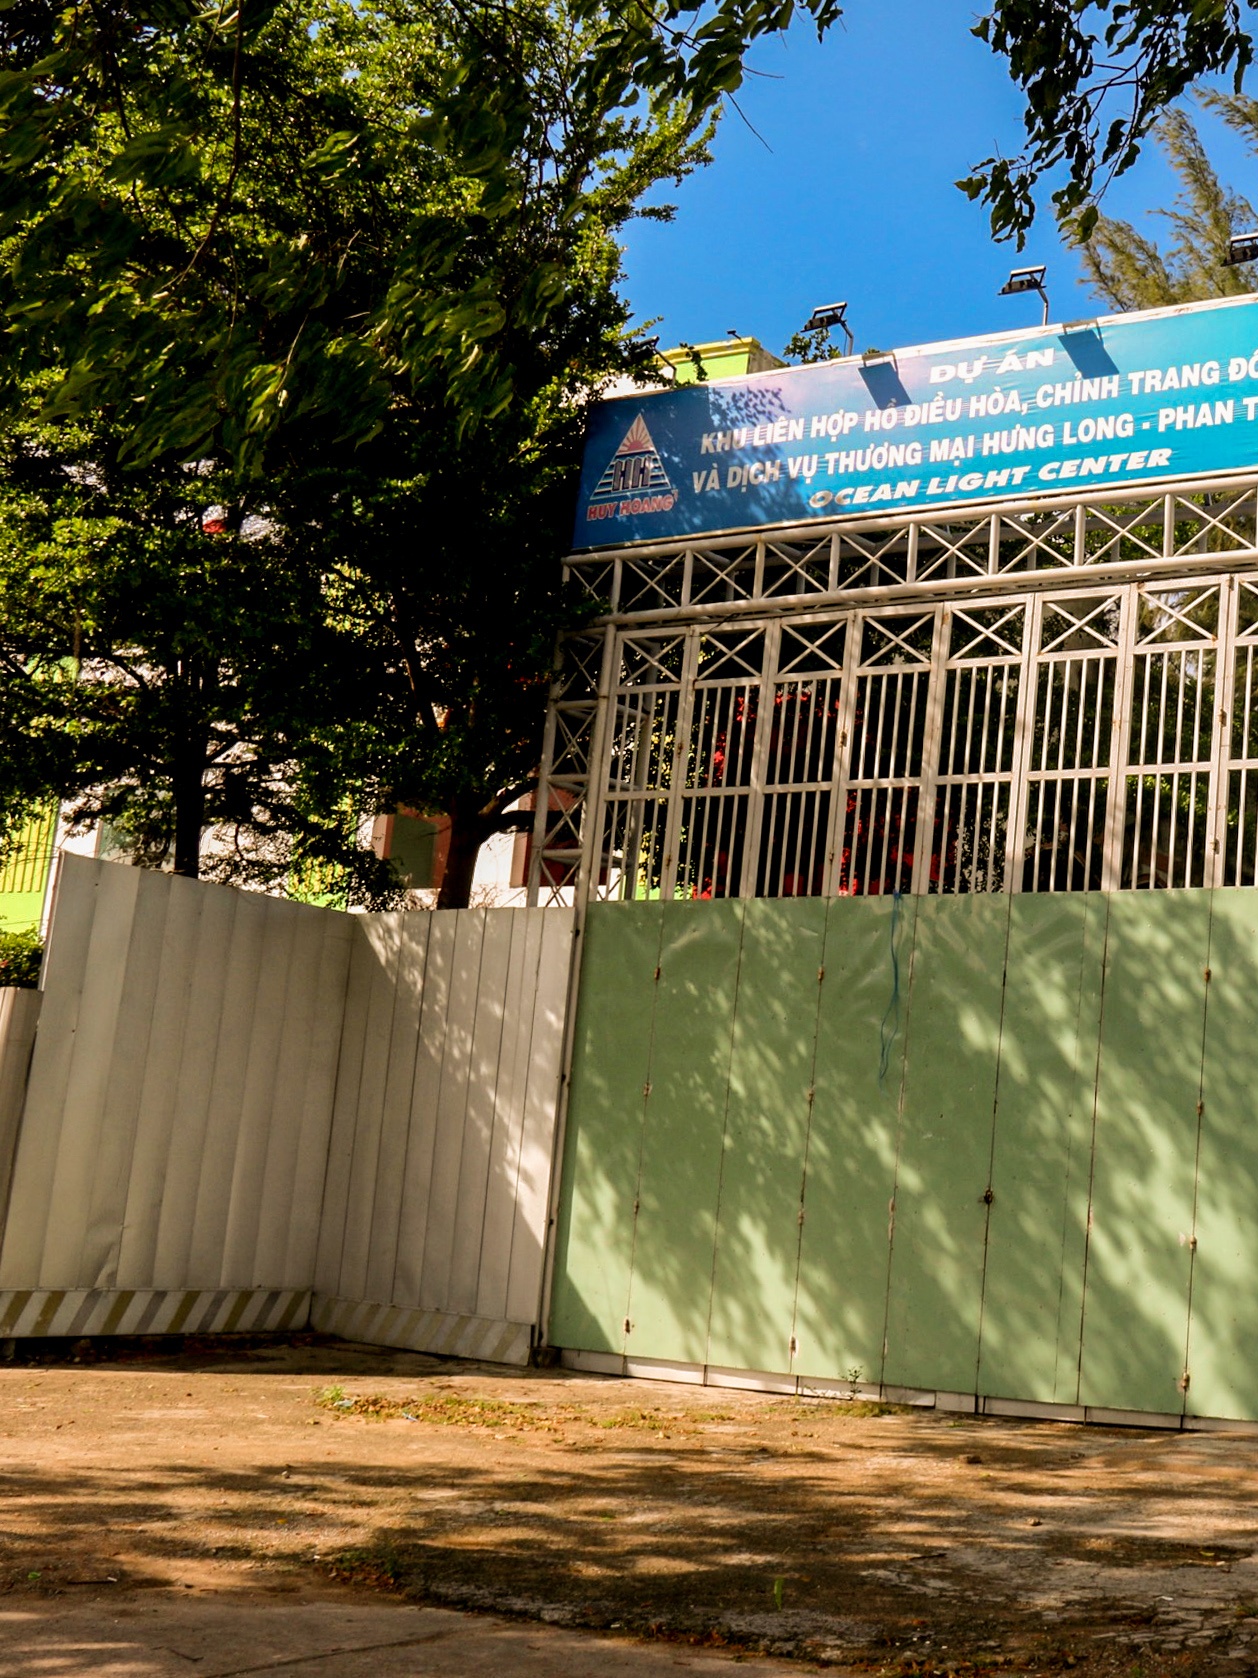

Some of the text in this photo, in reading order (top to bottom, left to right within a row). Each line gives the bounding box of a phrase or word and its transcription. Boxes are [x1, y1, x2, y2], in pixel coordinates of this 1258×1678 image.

[929, 347, 1056, 385] DỰ ÁN
[701, 427, 747, 454] KHU
[753, 415, 805, 446] LIÊN
[810, 409, 858, 442] HỢP
[864, 397, 898, 432] HỒ
[904, 391, 963, 427] ĐIỀU
[968, 386, 1029, 416] HÒA,
[1036, 371, 1121, 408] CHỈNH
[1127, 360, 1220, 396] TRANG
[692, 463, 721, 494] VÀ
[726, 459, 781, 493] DỊCH
[787, 454, 818, 484] VỤ
[824, 441, 922, 475] THƯƠNG
[929, 435, 976, 467] MẠI
[982, 423, 1055, 457] HƯNG
[1062, 413, 1135, 446] LONG
[1157, 399, 1235, 433] PHAN
[809, 448, 1173, 509] OCEAN LIGHT CENTER
[586, 501, 618, 522] HUY
